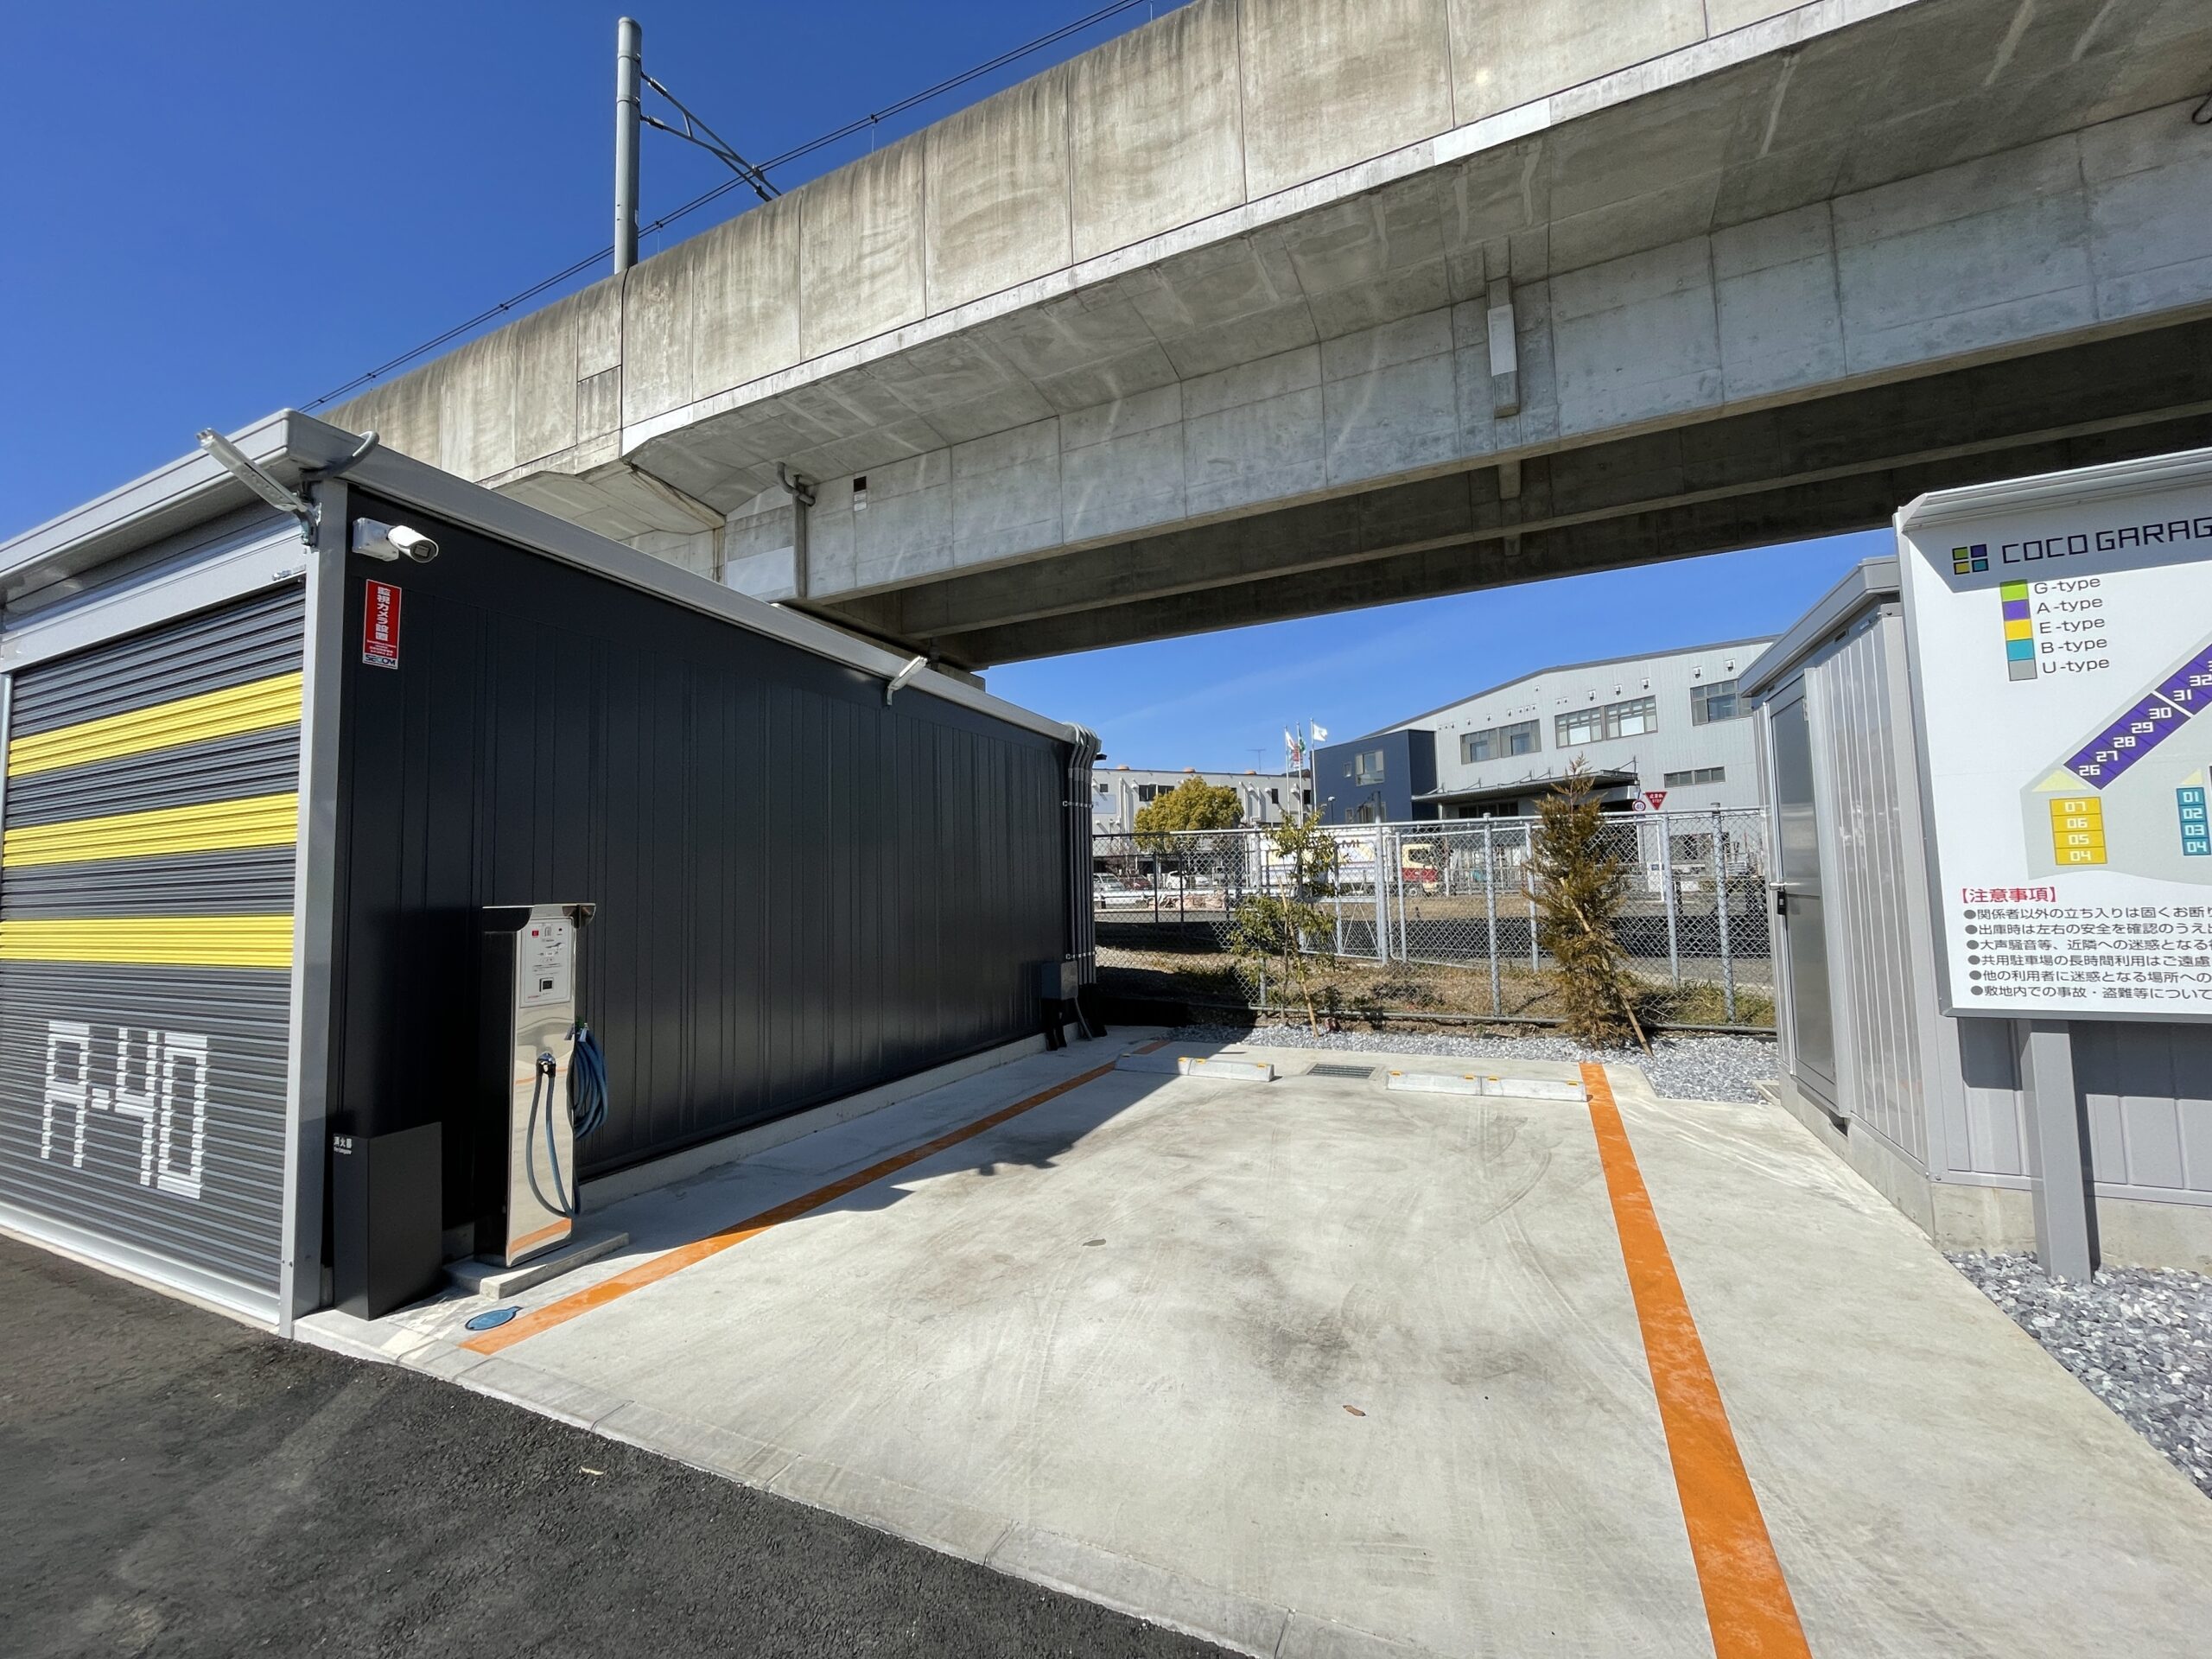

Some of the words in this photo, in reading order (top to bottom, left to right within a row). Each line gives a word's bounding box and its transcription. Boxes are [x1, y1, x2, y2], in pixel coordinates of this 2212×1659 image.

[2001, 534, 2088, 563] COCO
[2095, 518, 2212, 551] GARAG
[2034, 578, 2101, 594] G-type
[2037, 599, 2103, 614] A-type
[2039, 619, 2105, 633] E-type
[2041, 639, 2107, 654] B-type
[365, 654, 396, 665] SECOM
[2042, 658, 2110, 674] U-type
[2190, 674, 2212, 687] 32
[2173, 689, 2192, 702] 31
[2148, 707, 2172, 720] 30
[2131, 721, 2154, 734] 29
[2113, 736, 2136, 748] 28
[2095, 750, 2118, 762] 27
[2078, 765, 2101, 776] 26
[2183, 791, 2199, 803] 01
[2064, 801, 2087, 812] 07
[2183, 808, 2202, 819] 02
[2067, 817, 2088, 829] 06
[2184, 824, 2205, 836] 03
[2069, 834, 2089, 845] 05
[2187, 841, 2207, 853] 04
[2070, 850, 2091, 861] 04
